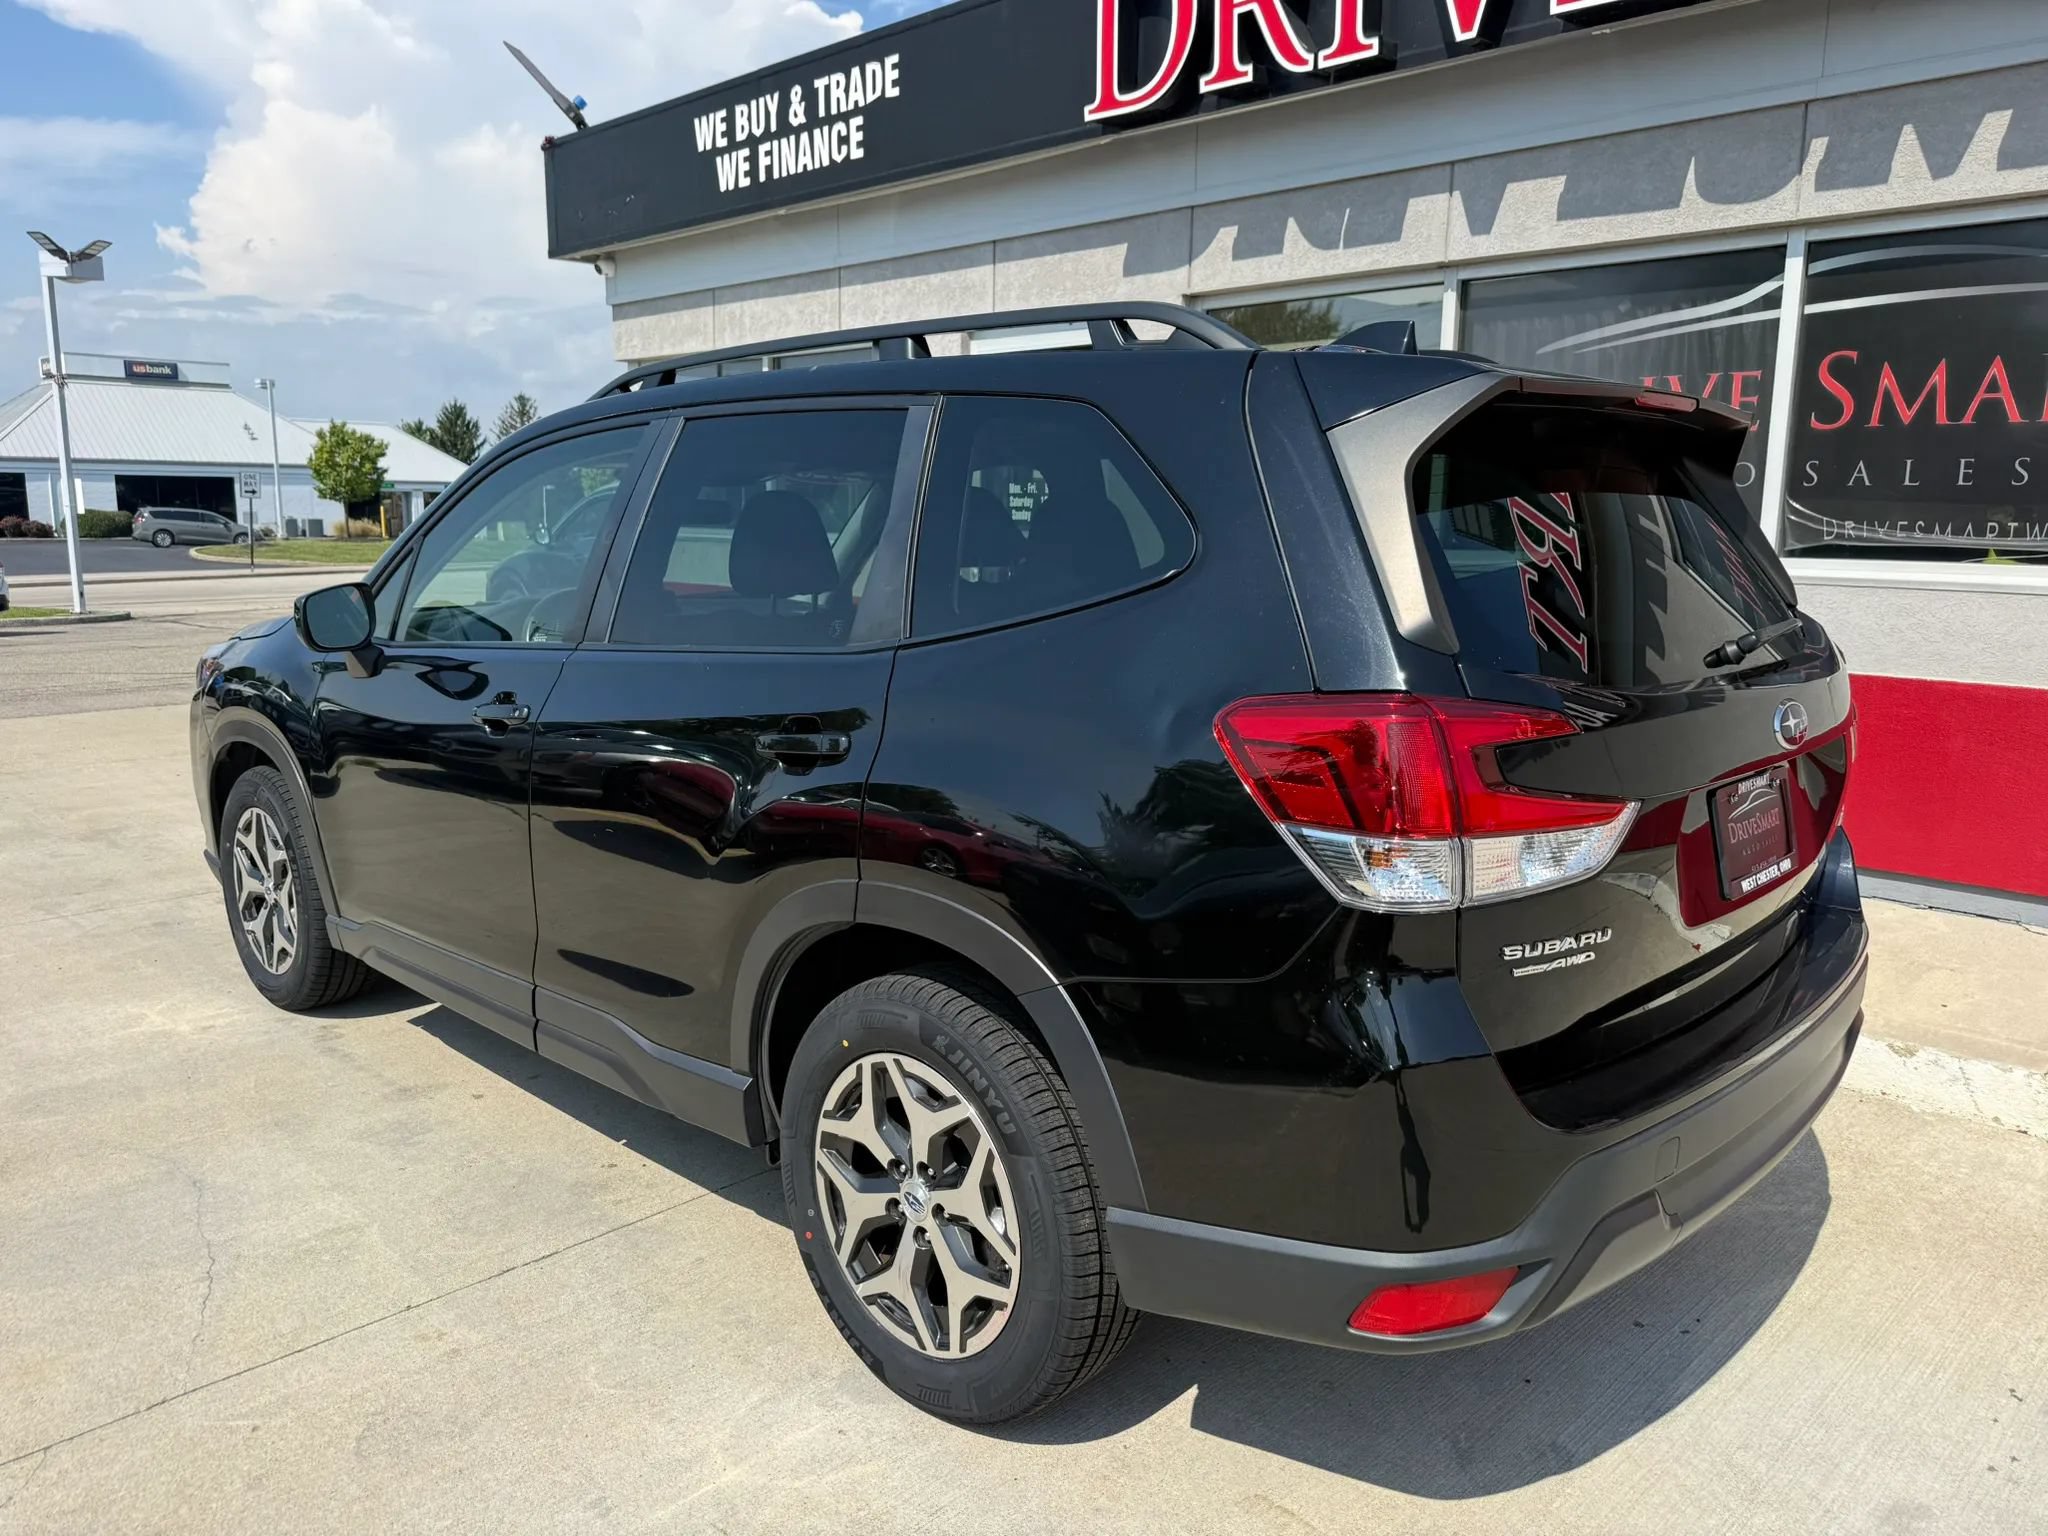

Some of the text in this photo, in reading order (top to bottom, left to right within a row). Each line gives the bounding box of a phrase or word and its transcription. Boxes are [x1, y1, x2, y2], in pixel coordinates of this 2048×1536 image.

[694, 53, 900, 152] WE BUY & TRADE
[716, 115, 864, 192] WE FINANCE
[1810, 350, 2048, 431] SMA
[1803, 457, 2031, 487] SALES
[1741, 875, 1758, 893] WEST
[1501, 927, 1613, 961] SUBARU
[1546, 951, 1597, 972] AWD
[947, 1049, 1017, 1134] JINYU
